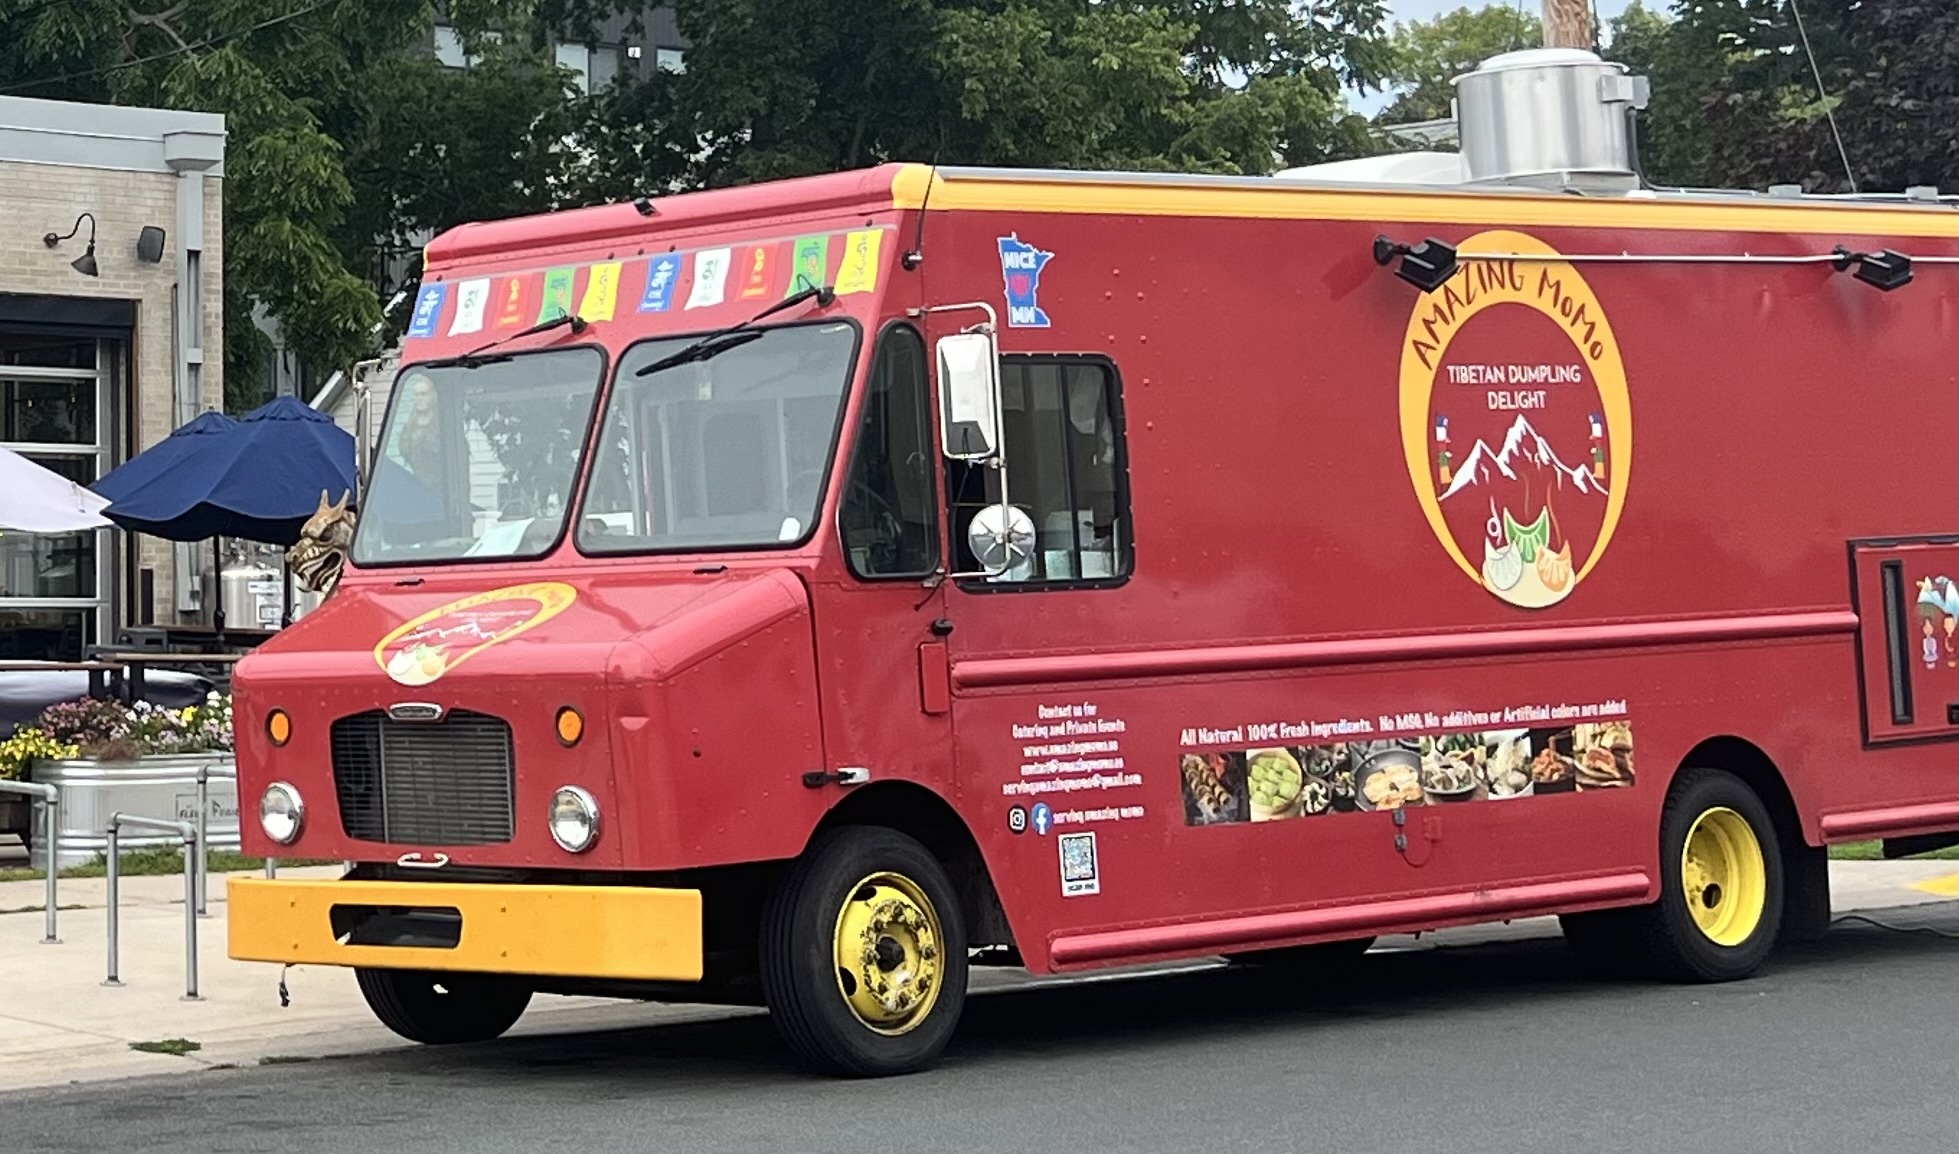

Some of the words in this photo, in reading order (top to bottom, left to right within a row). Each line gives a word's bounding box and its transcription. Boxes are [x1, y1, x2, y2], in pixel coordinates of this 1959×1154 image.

[1004, 251, 1037, 269] NICE
[1011, 306, 1035, 323] MN
[1412, 252, 1525, 371] AMAZING
[1447, 365, 1505, 384] TIBETAN
[1508, 364, 1582, 383] DUMPLING
[1487, 391, 1547, 410] DELIGHT
[1039, 704, 1072, 719] Contact
[1073, 705, 1083, 717] us
[1083, 701, 1097, 716] for
[1012, 724, 1049, 739] Catering
[1049, 721, 1065, 736] and
[1065, 720, 1097, 736] Private
[1097, 718, 1125, 733] Events
[1180, 728, 1197, 746] All
[1198, 725, 1243, 745] Natural
[1247, 722, 1278, 742] 100%
[1280, 721, 1309, 739] Fresh
[1379, 715, 1395, 732] No
[1424, 711, 1440, 728] No
[1442, 709, 1489, 728] additives
[1490, 710, 1502, 724] or
[1504, 704, 1550, 723] Artificial
[1551, 703, 1580, 719] colors
[1582, 703, 1598, 717] are
[1599, 699, 1627, 716] added
[1053, 808, 1084, 824] serving
[1085, 806, 1119, 821] amazing
[1120, 806, 1144, 818] momo
